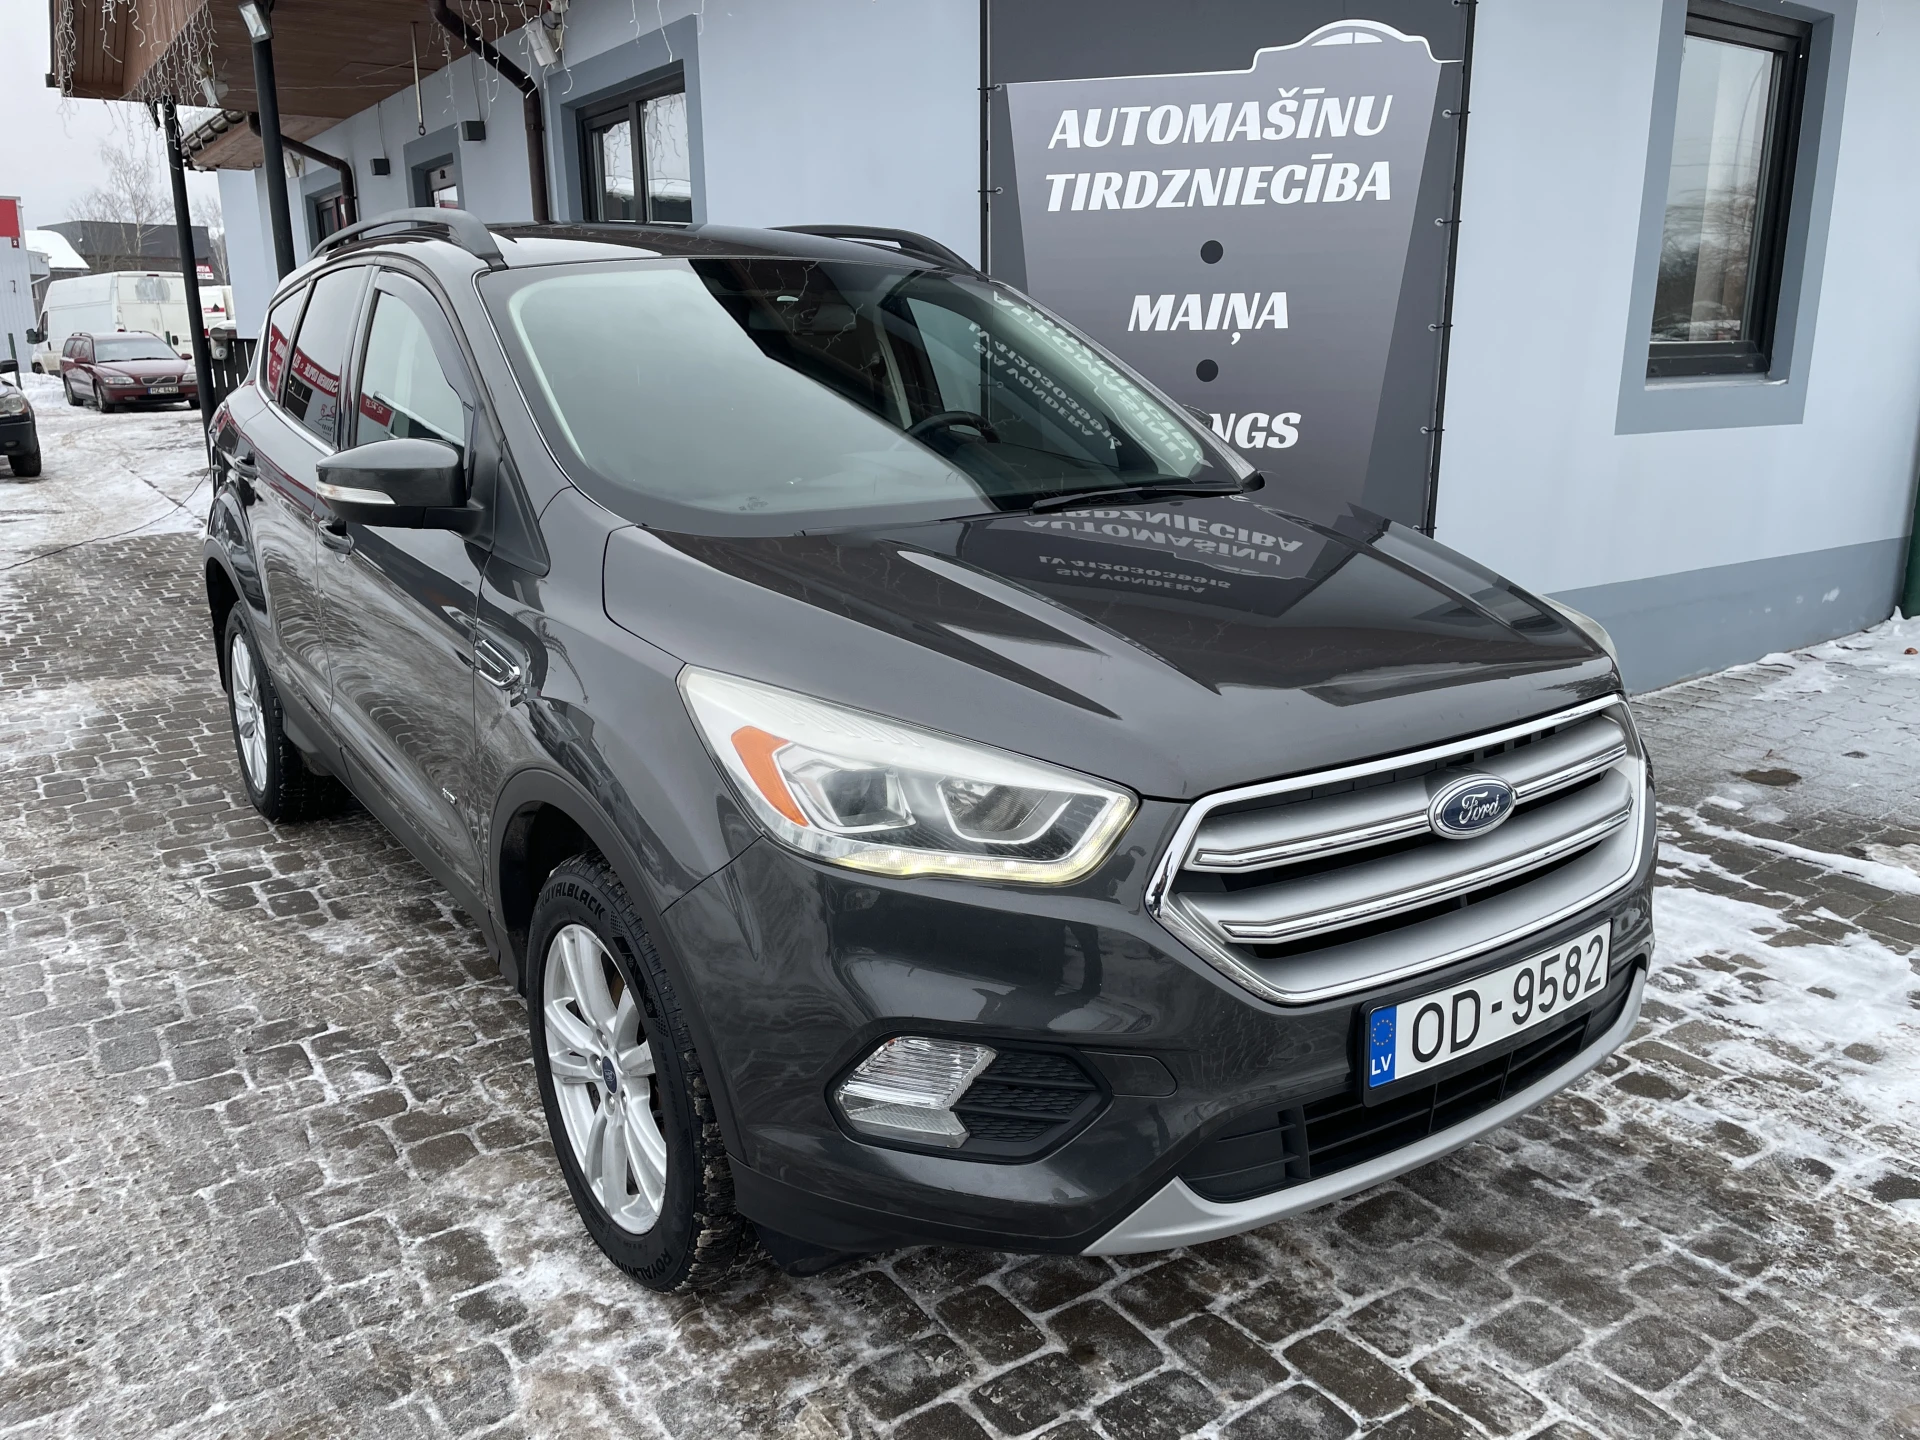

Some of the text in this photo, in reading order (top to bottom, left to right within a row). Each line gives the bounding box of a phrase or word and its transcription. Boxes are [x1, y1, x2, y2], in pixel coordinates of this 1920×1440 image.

[1047, 87, 1394, 150] AUTOMAŠĪNU
[1044, 153, 1392, 212] TIRDZNIECĪBA
[1127, 291, 1289, 346] MAIŅA
[1208, 411, 1302, 449] NGS
[1459, 791, 1501, 824] Ford
[1411, 934, 1604, 1063] OD-9582
[1371, 1053, 1392, 1076] LV
